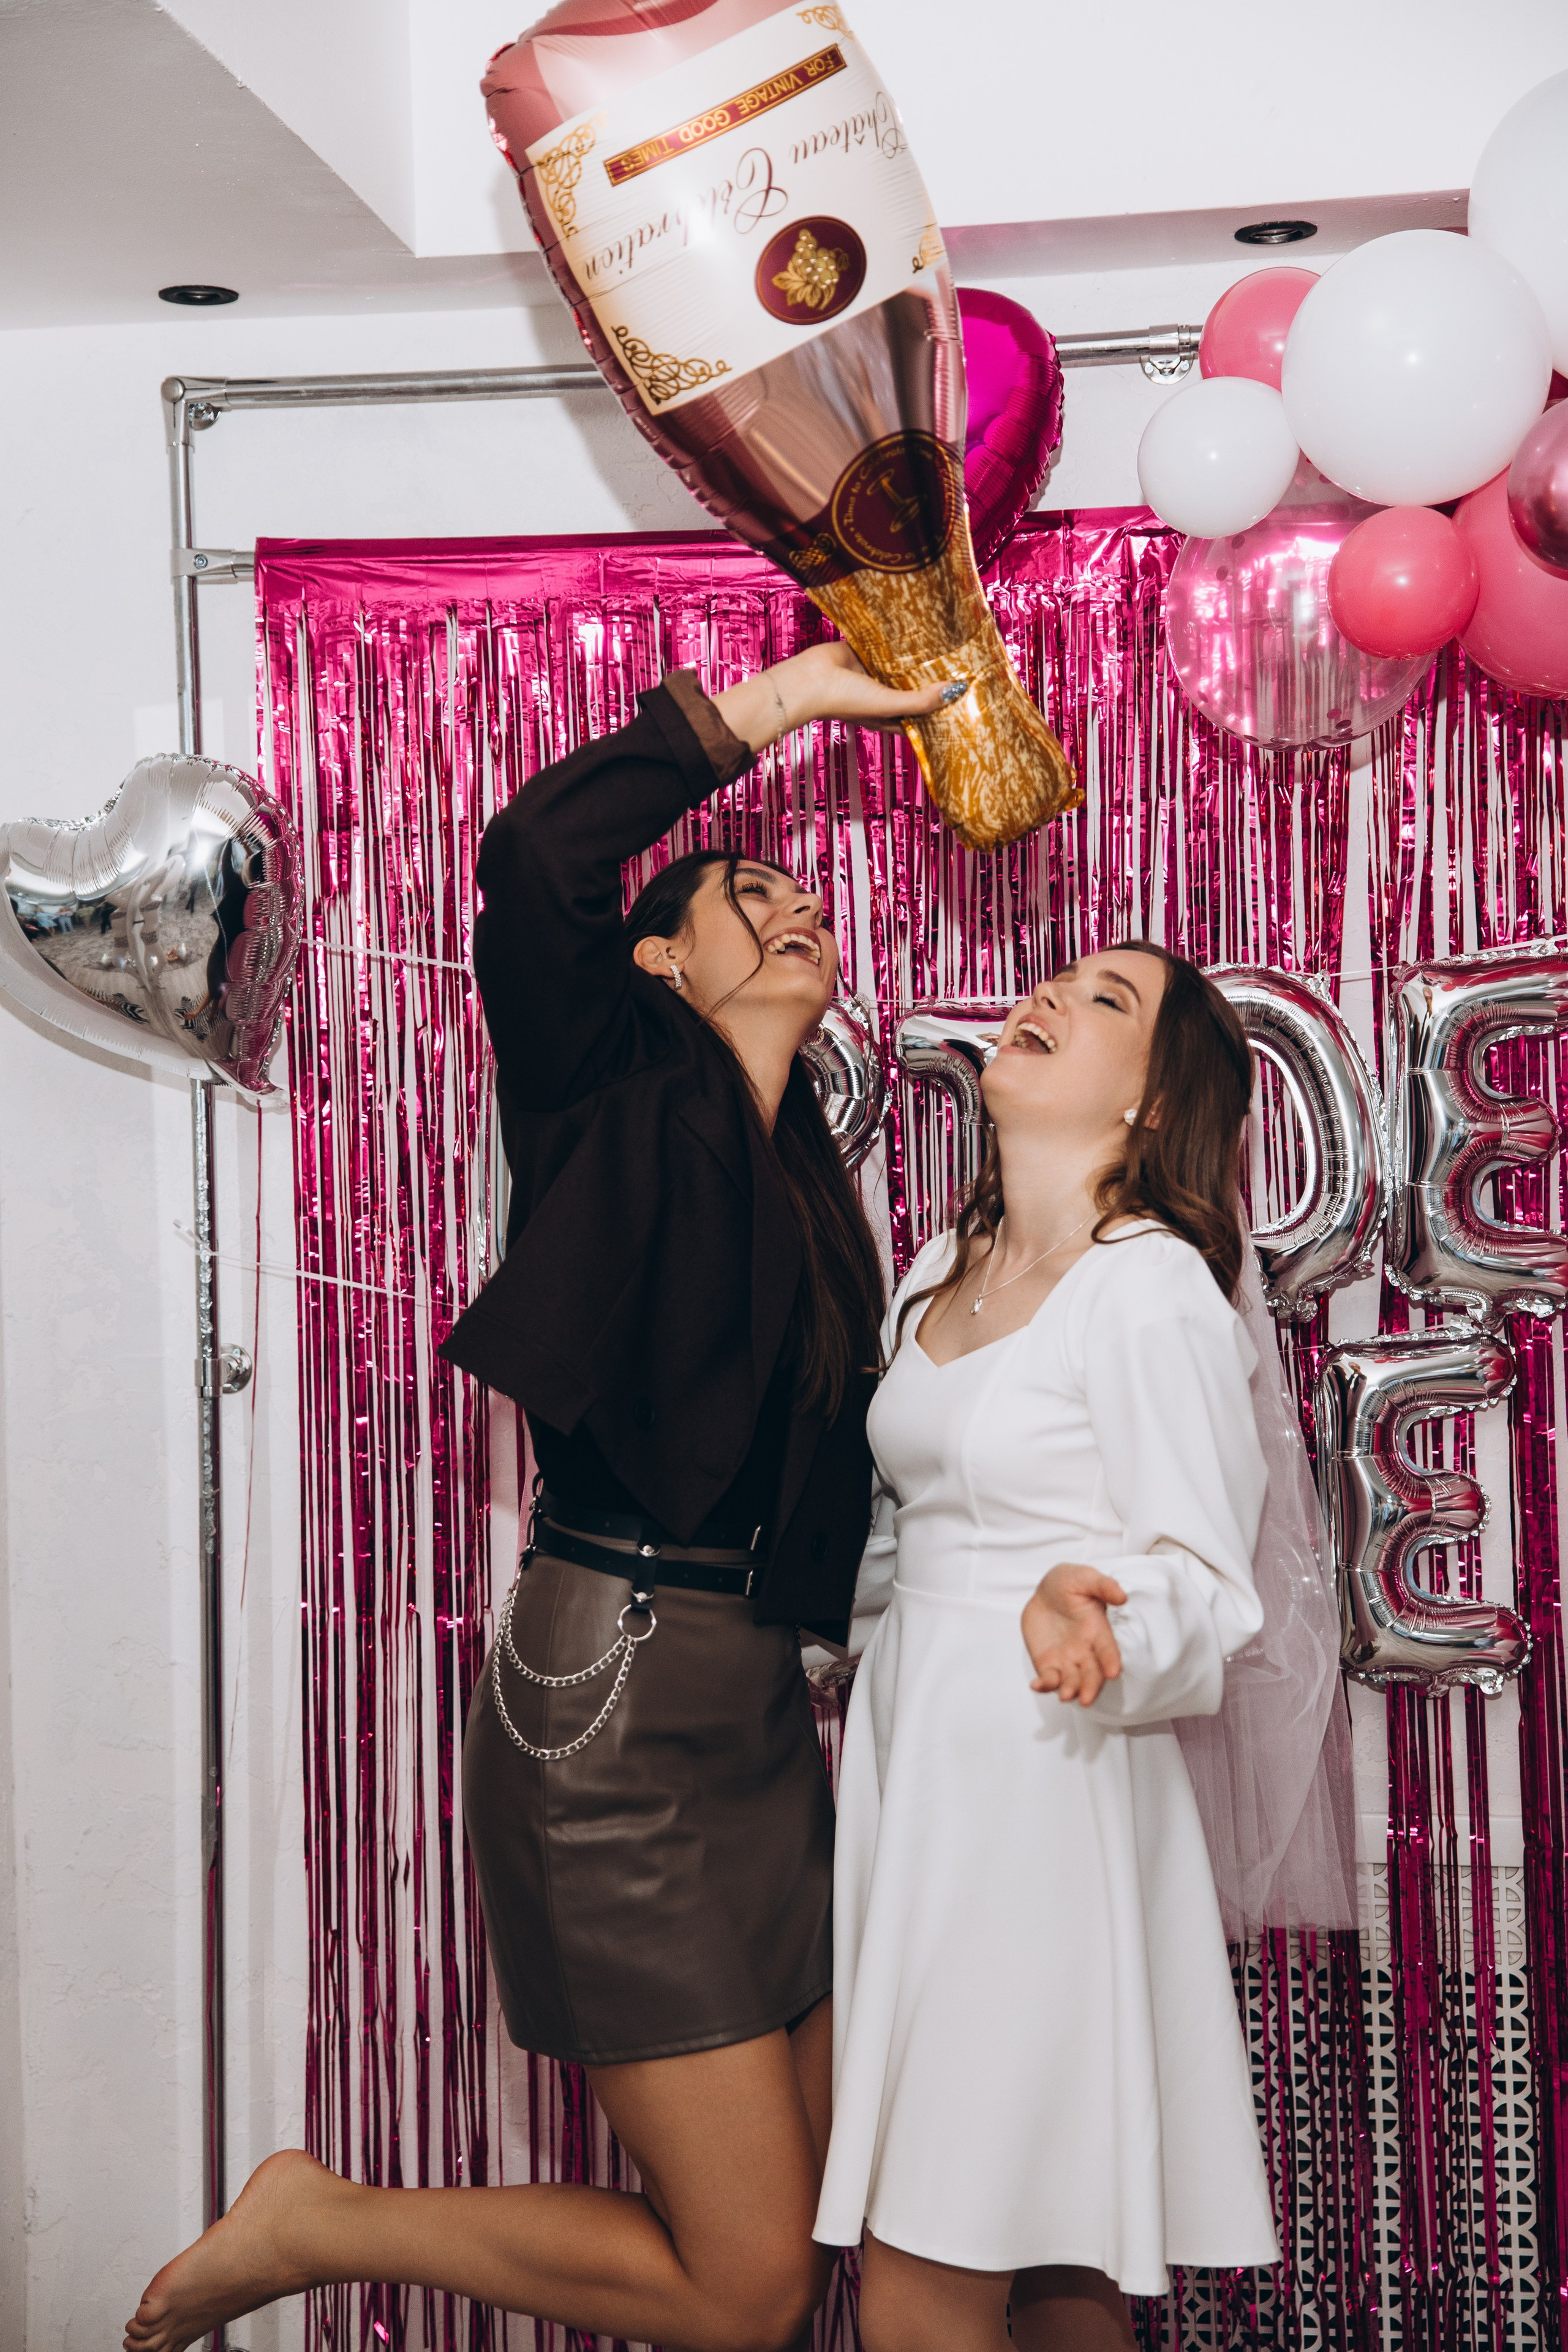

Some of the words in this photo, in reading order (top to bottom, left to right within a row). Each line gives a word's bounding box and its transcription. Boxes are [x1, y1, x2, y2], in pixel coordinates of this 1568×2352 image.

[805, 53, 835, 77] FOR
[736, 72, 803, 116] VINTAGE
[678, 108, 732, 144] GOOD
[622, 138, 674, 172] TIMES
